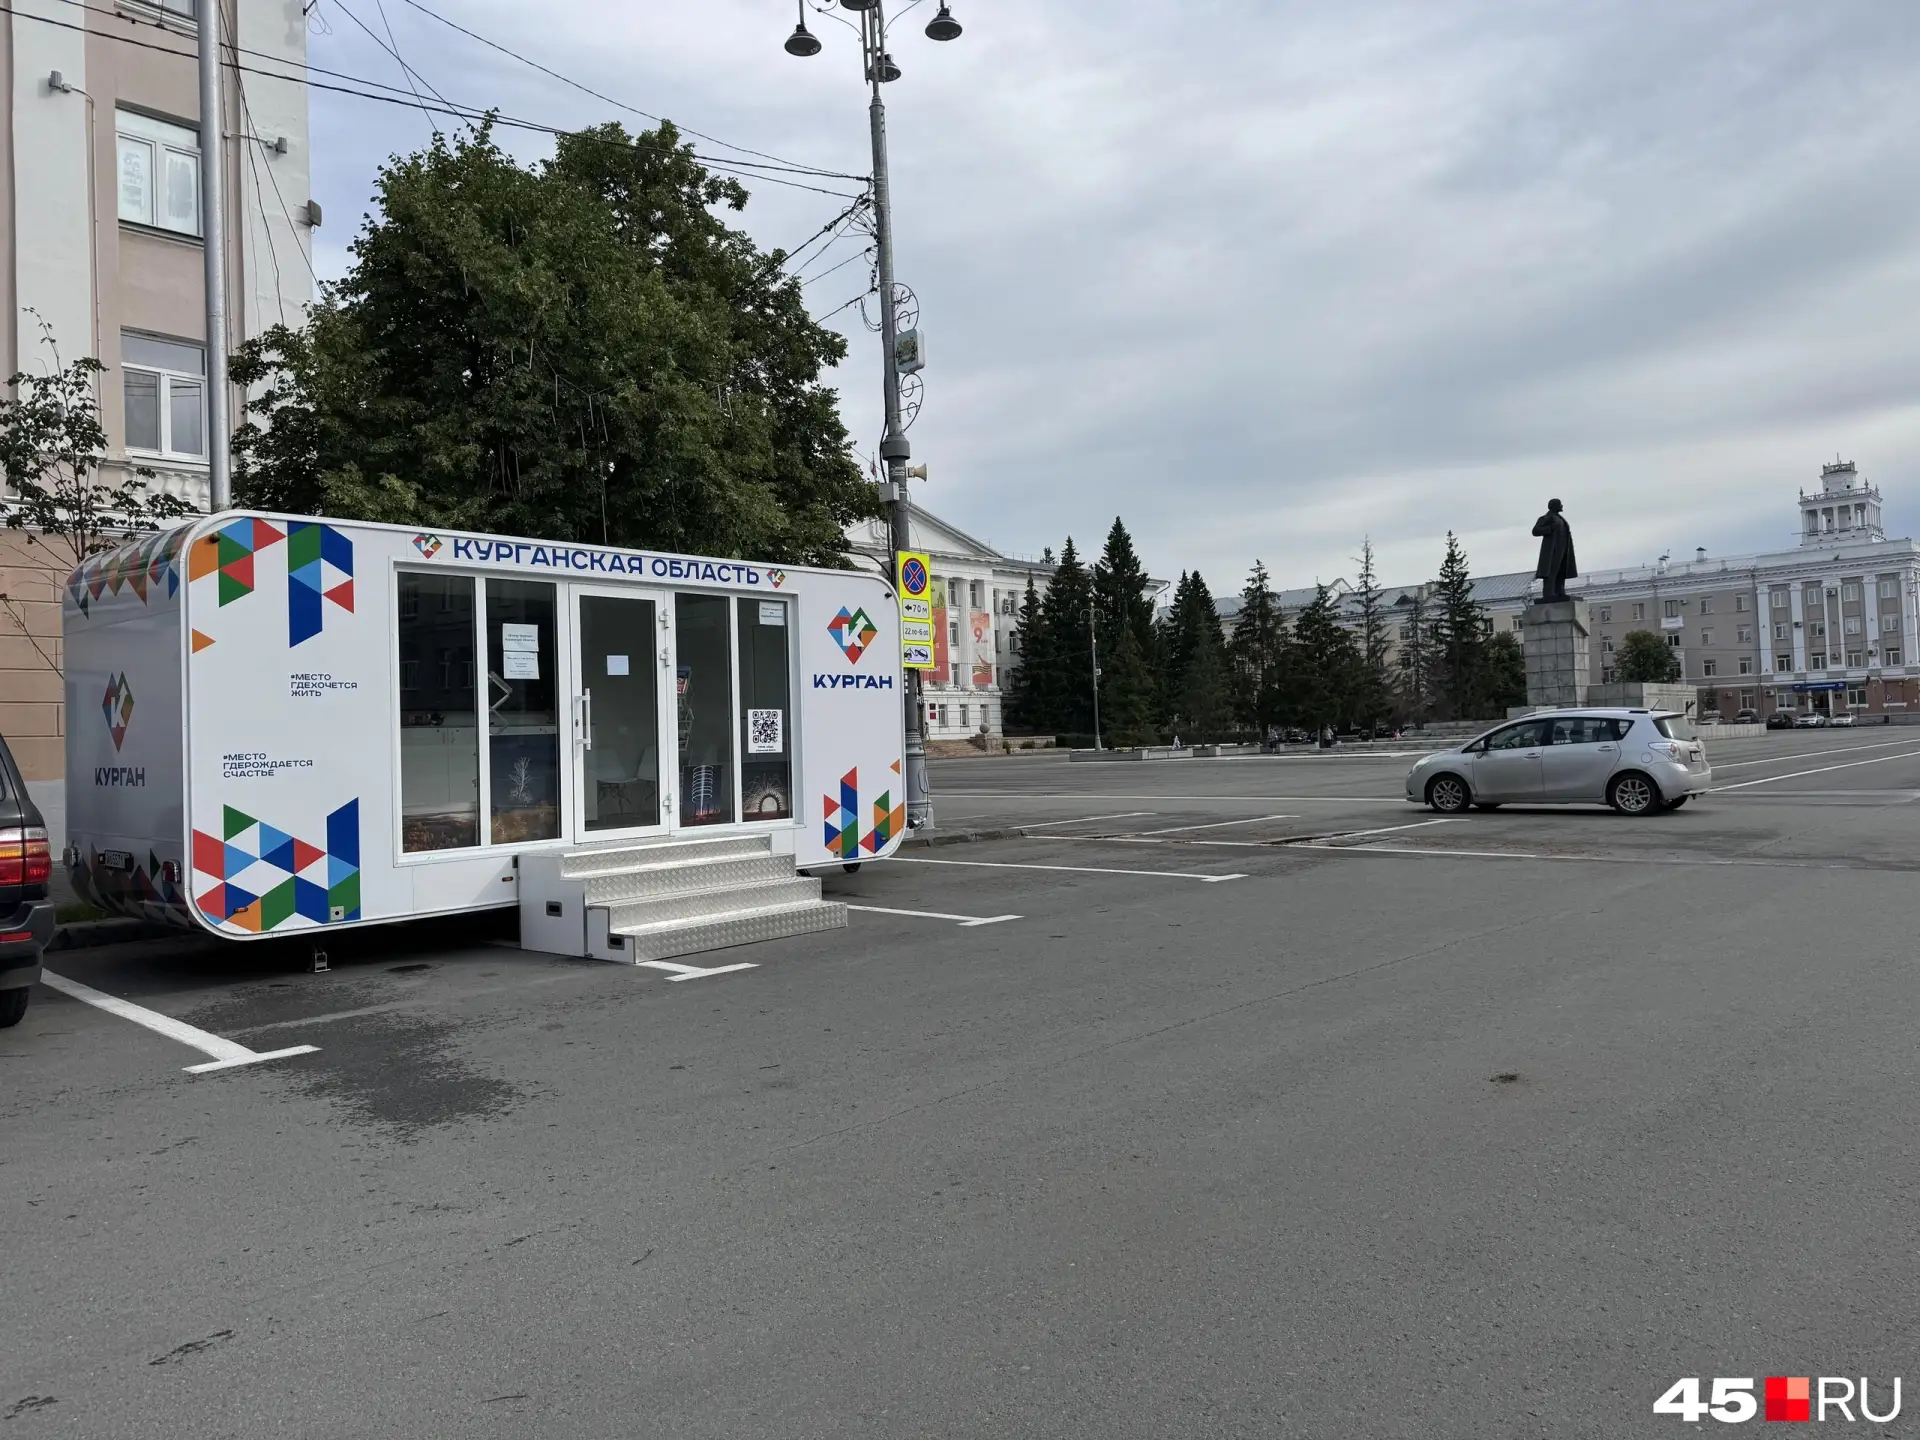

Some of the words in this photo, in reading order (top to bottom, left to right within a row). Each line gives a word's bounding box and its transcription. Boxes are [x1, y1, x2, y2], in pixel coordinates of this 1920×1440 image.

[453, 538, 643, 575] КУРГАНСКАЯ
[651, 558, 760, 585] ОБЛАСТЬ
[912, 604, 922, 613] 70
[290, 681, 358, 690] ГДЕХОЧЕТСЯ
[813, 674, 893, 689] КУРГАН
[223, 752, 267, 761] #МЕСТО
[223, 759, 314, 771] ГДЕРОЖДАЕТСЯ
[94, 766, 146, 787] КУРГАН
[223, 769, 275, 778] СЧАСТЬЕ
